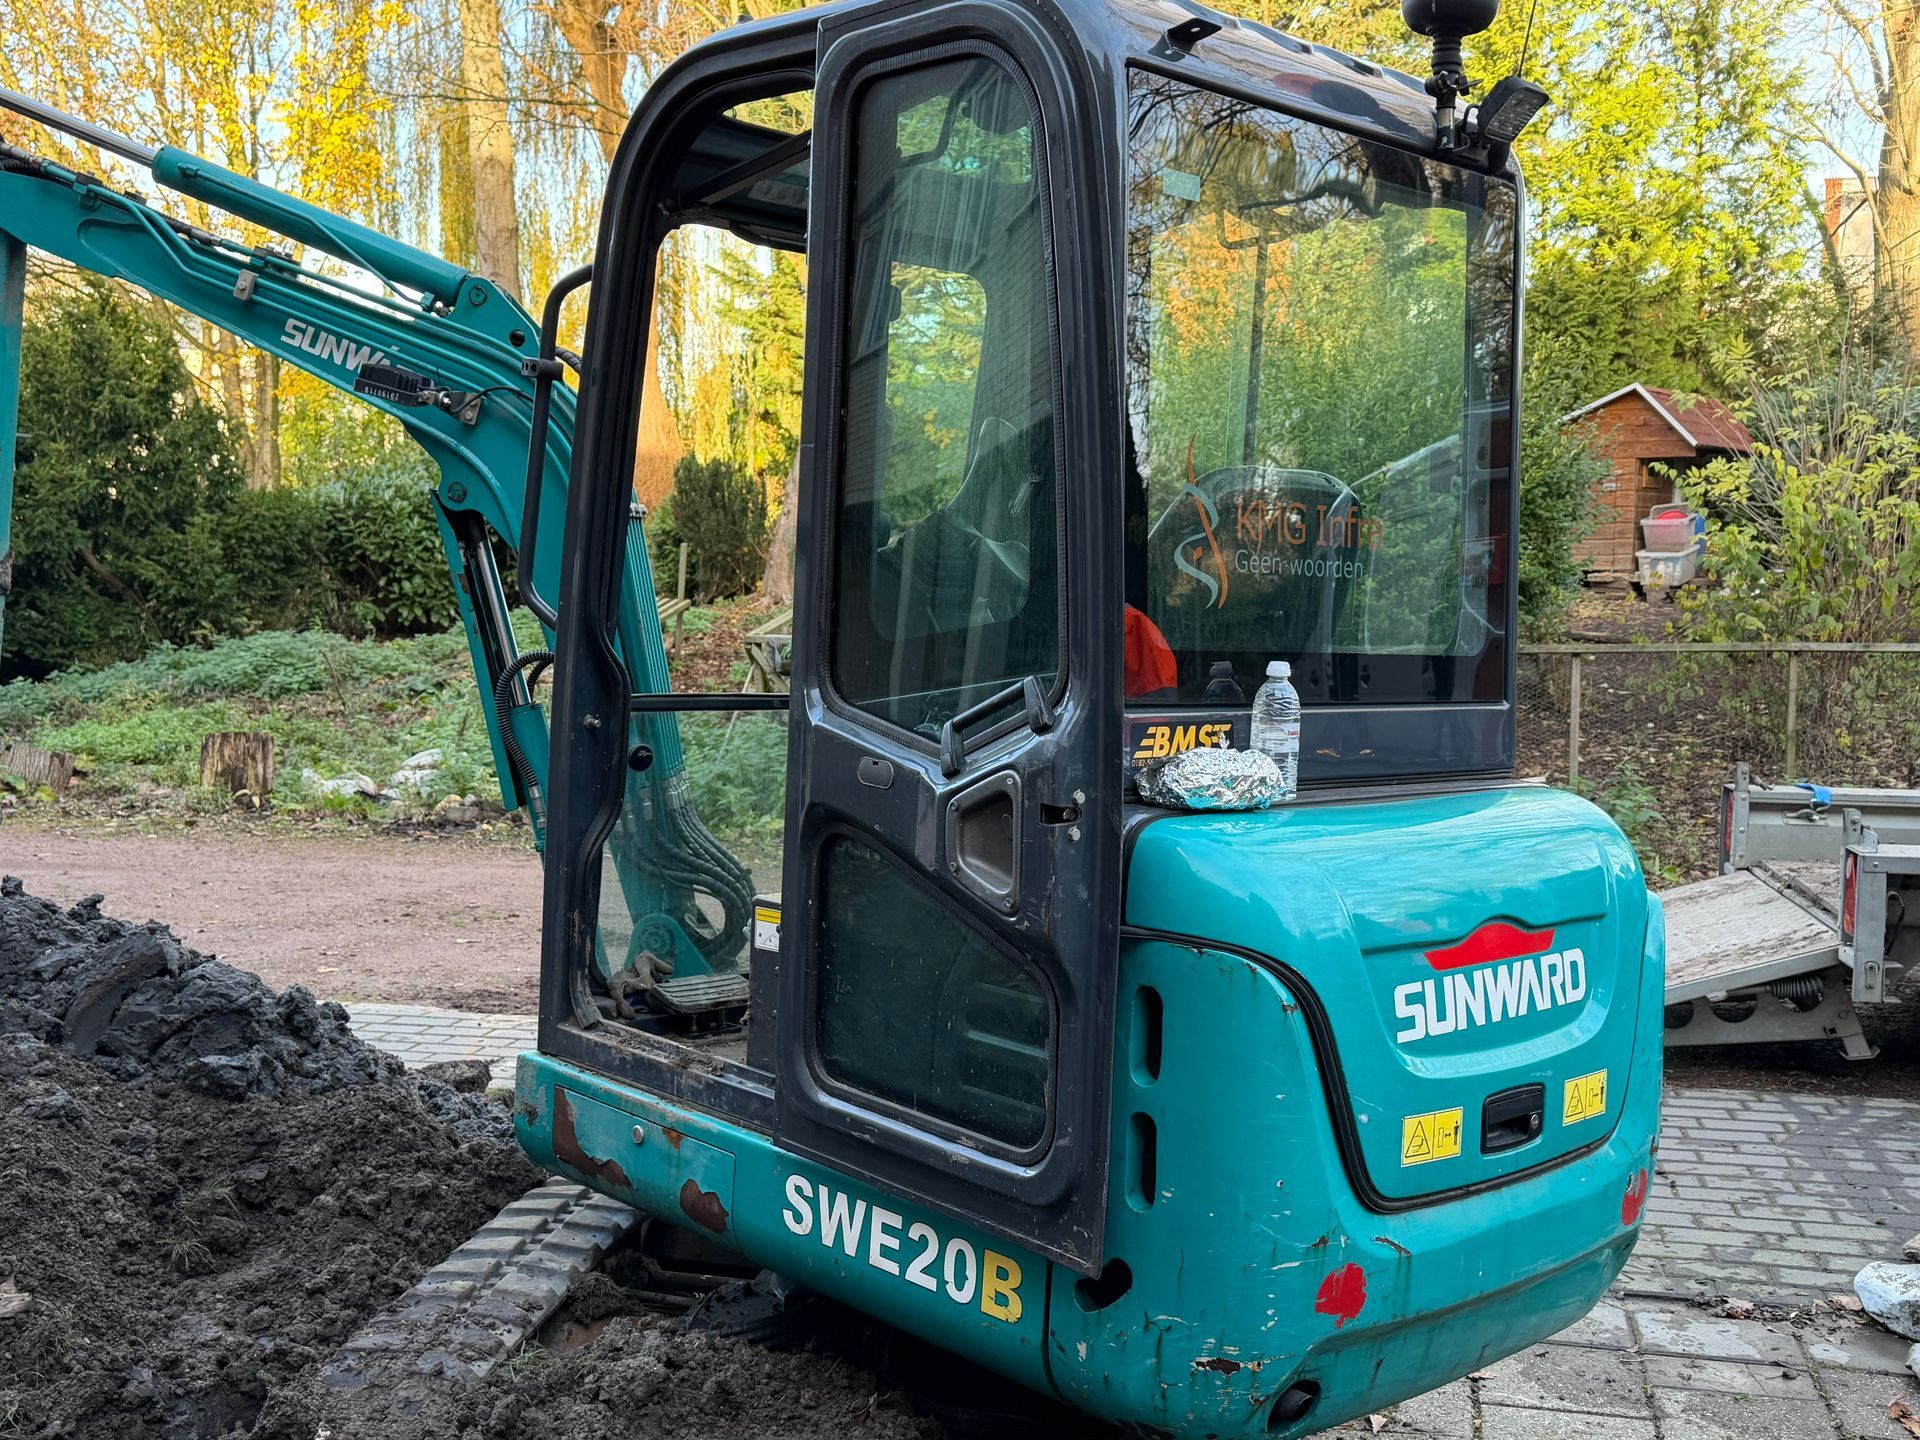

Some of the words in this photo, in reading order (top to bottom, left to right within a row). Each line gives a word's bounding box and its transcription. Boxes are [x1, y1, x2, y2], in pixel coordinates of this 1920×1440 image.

[1237, 499, 1307, 545] KMG
[1316, 504, 1384, 550] Infra
[1234, 549, 1283, 575] Geen
[1289, 555, 1364, 579] woorden
[1394, 948, 1586, 1044] SUNWARD
[782, 1174, 1023, 1324] SWE20B
